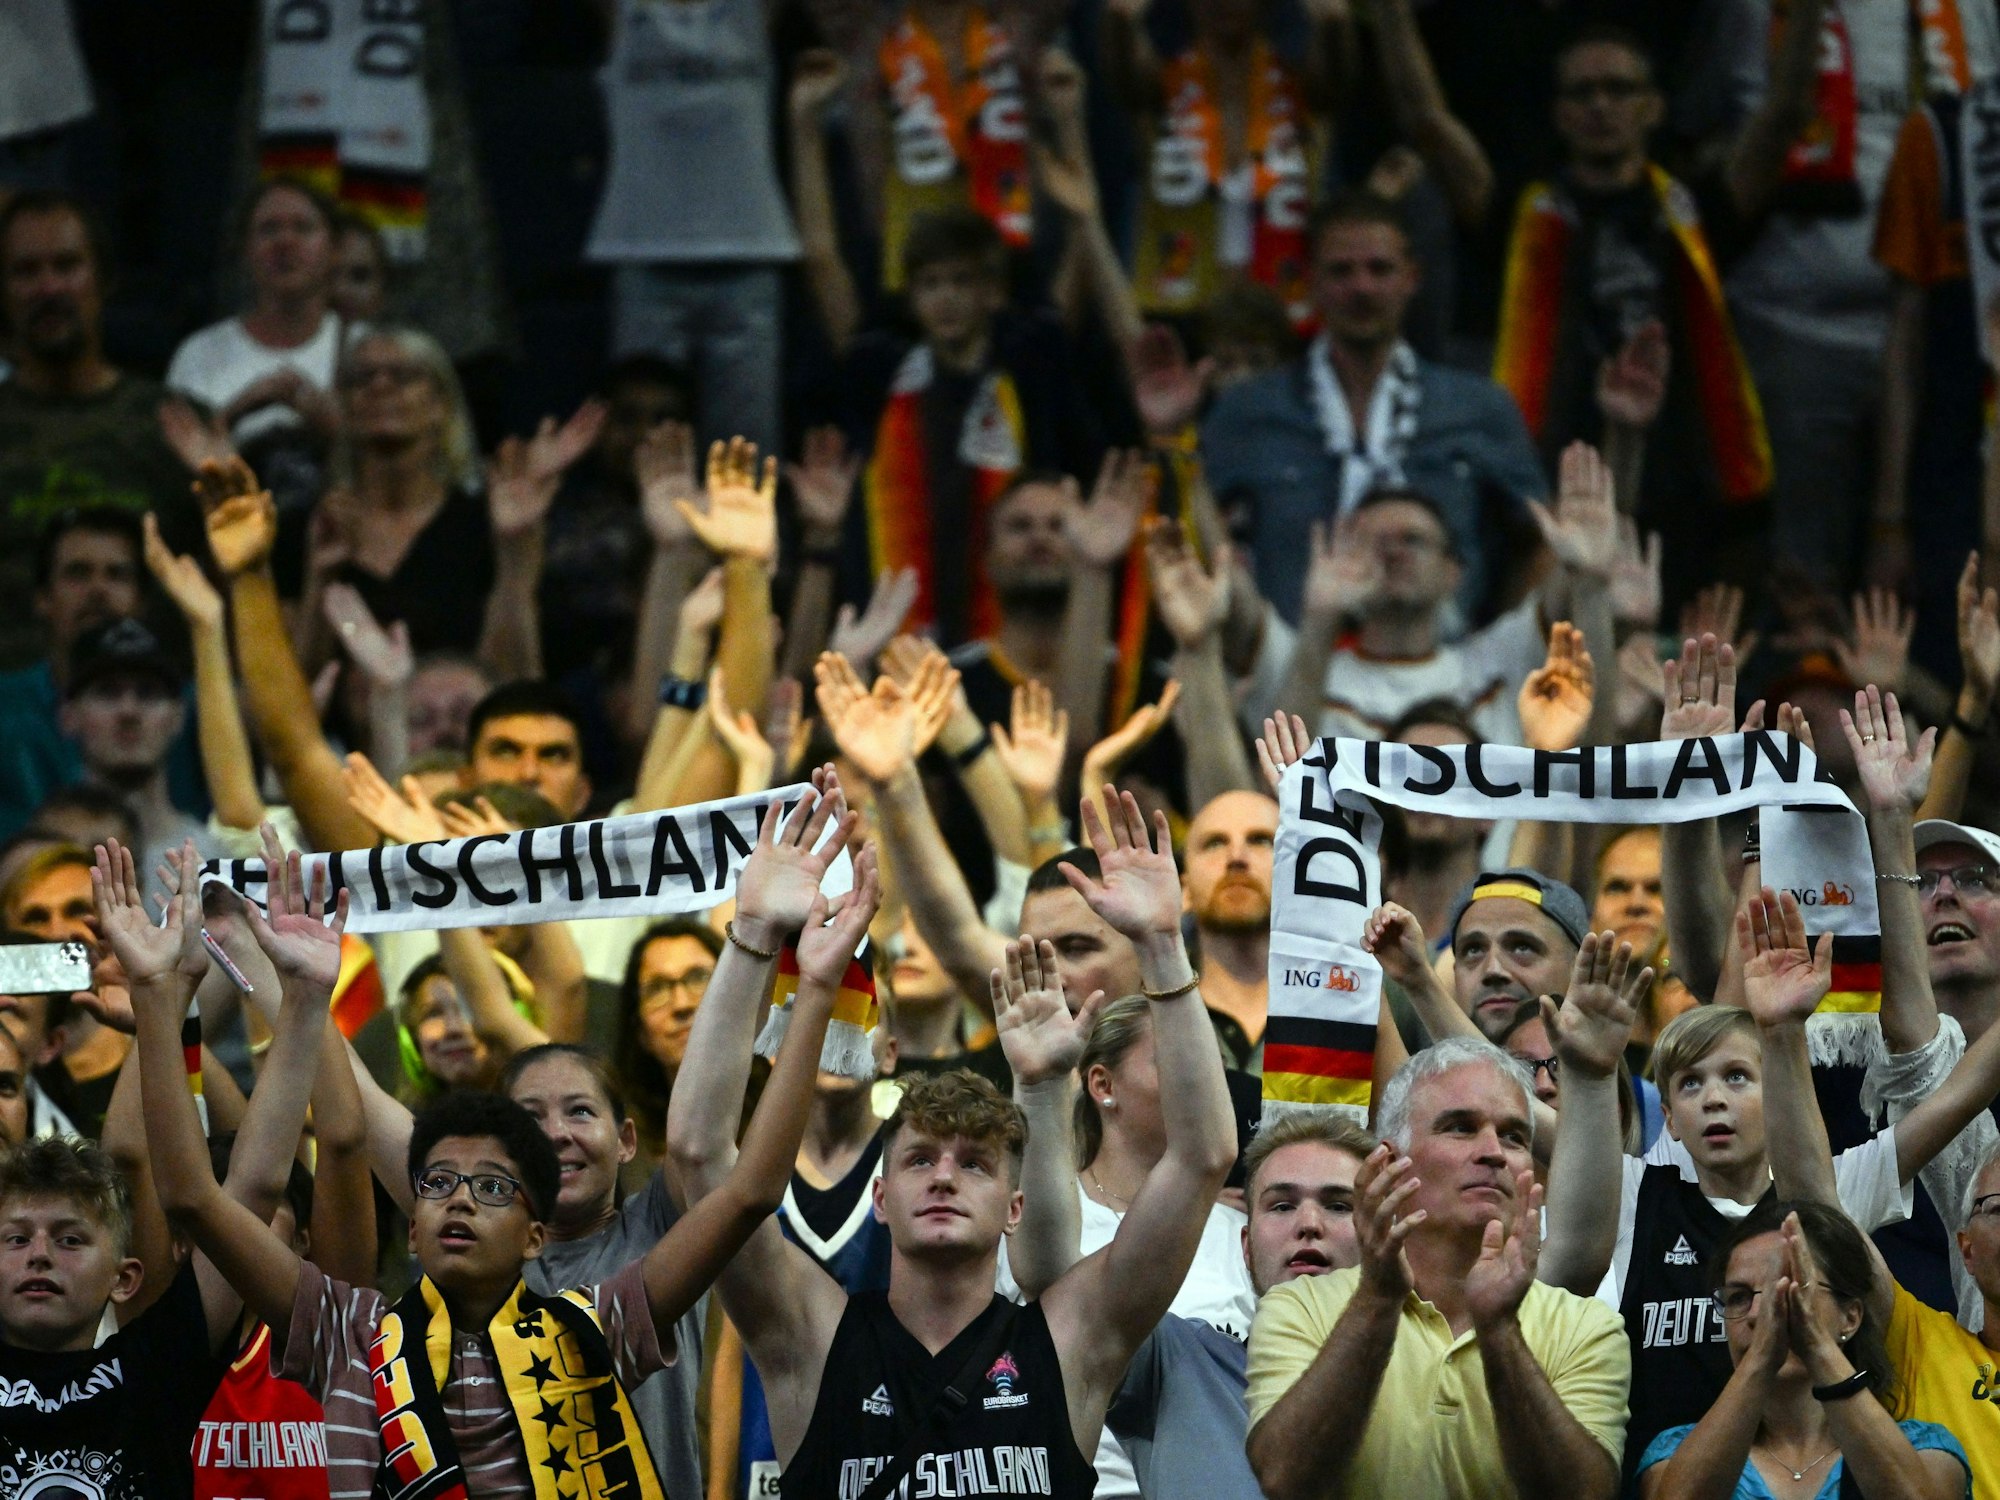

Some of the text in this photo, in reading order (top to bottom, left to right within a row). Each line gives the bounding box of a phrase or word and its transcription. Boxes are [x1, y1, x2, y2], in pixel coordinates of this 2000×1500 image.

[1781, 888, 1817, 906] NG
[1283, 969, 1321, 988] ING
[1664, 1250, 1699, 1265] PEAK
[983, 1393, 1029, 1407] EUROBASKET
